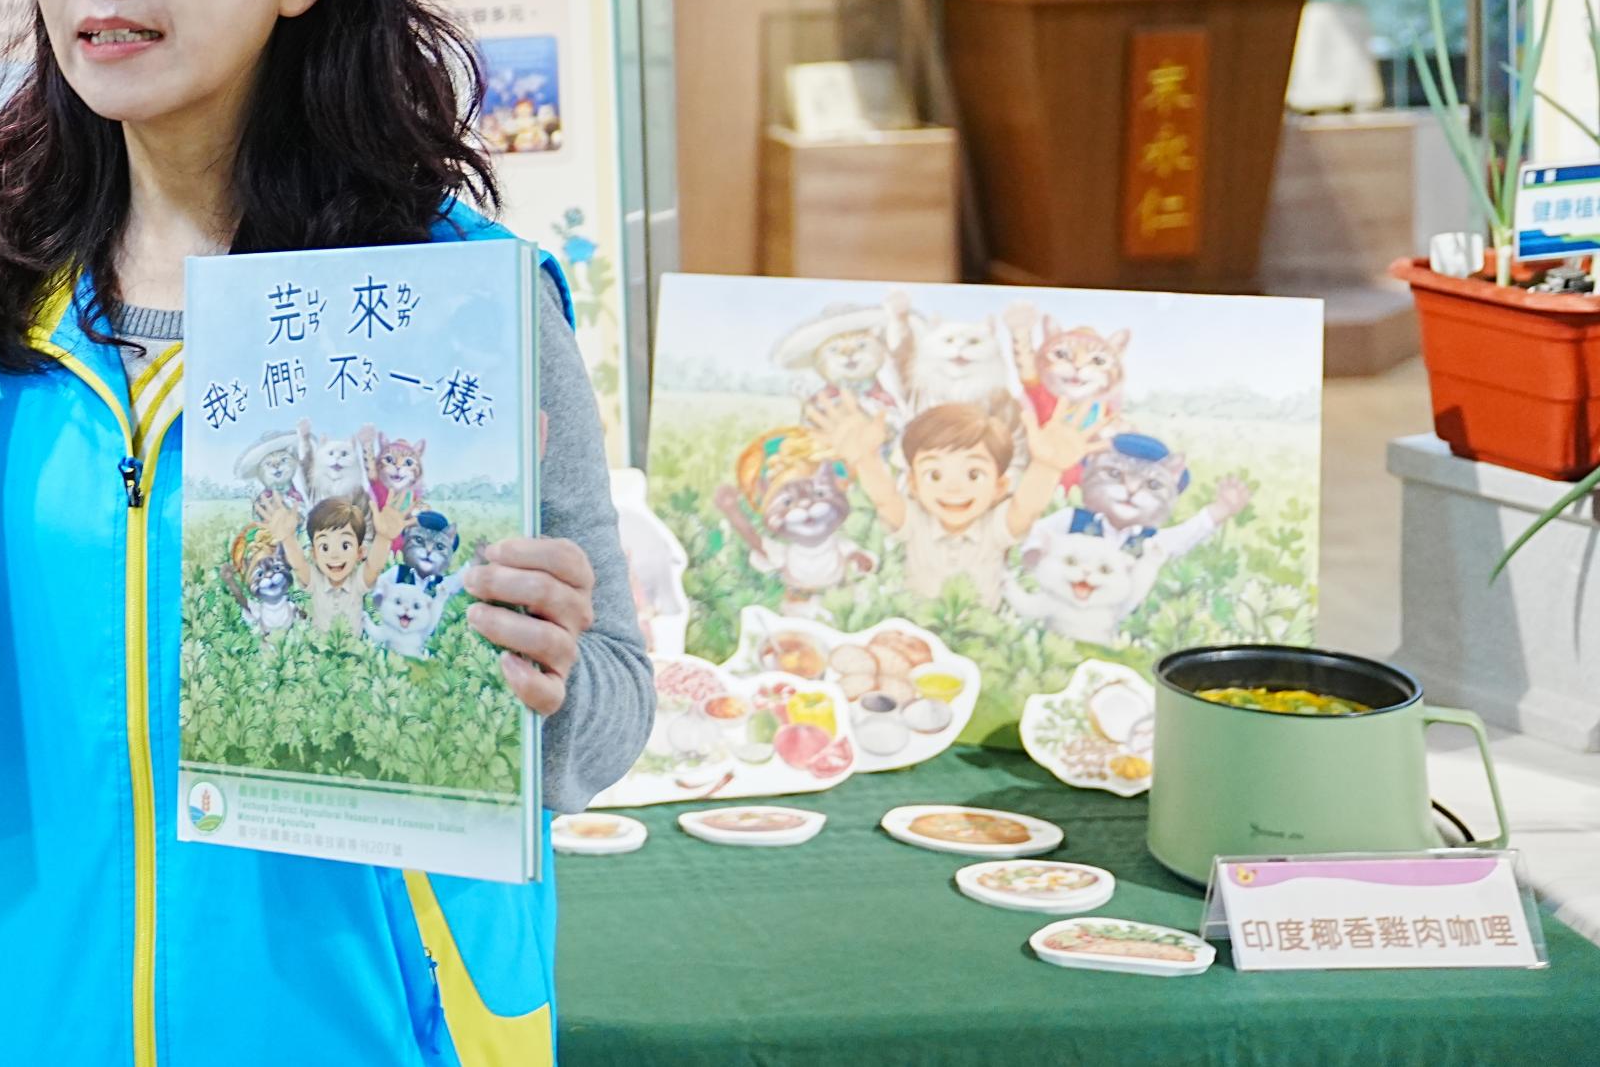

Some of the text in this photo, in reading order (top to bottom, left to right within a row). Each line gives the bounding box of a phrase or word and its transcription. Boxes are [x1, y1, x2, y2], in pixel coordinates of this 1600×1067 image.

[1534, 195, 1600, 223] 健康植
[1242, 914, 1518, 952] 印度椰香雞肉咖哩
